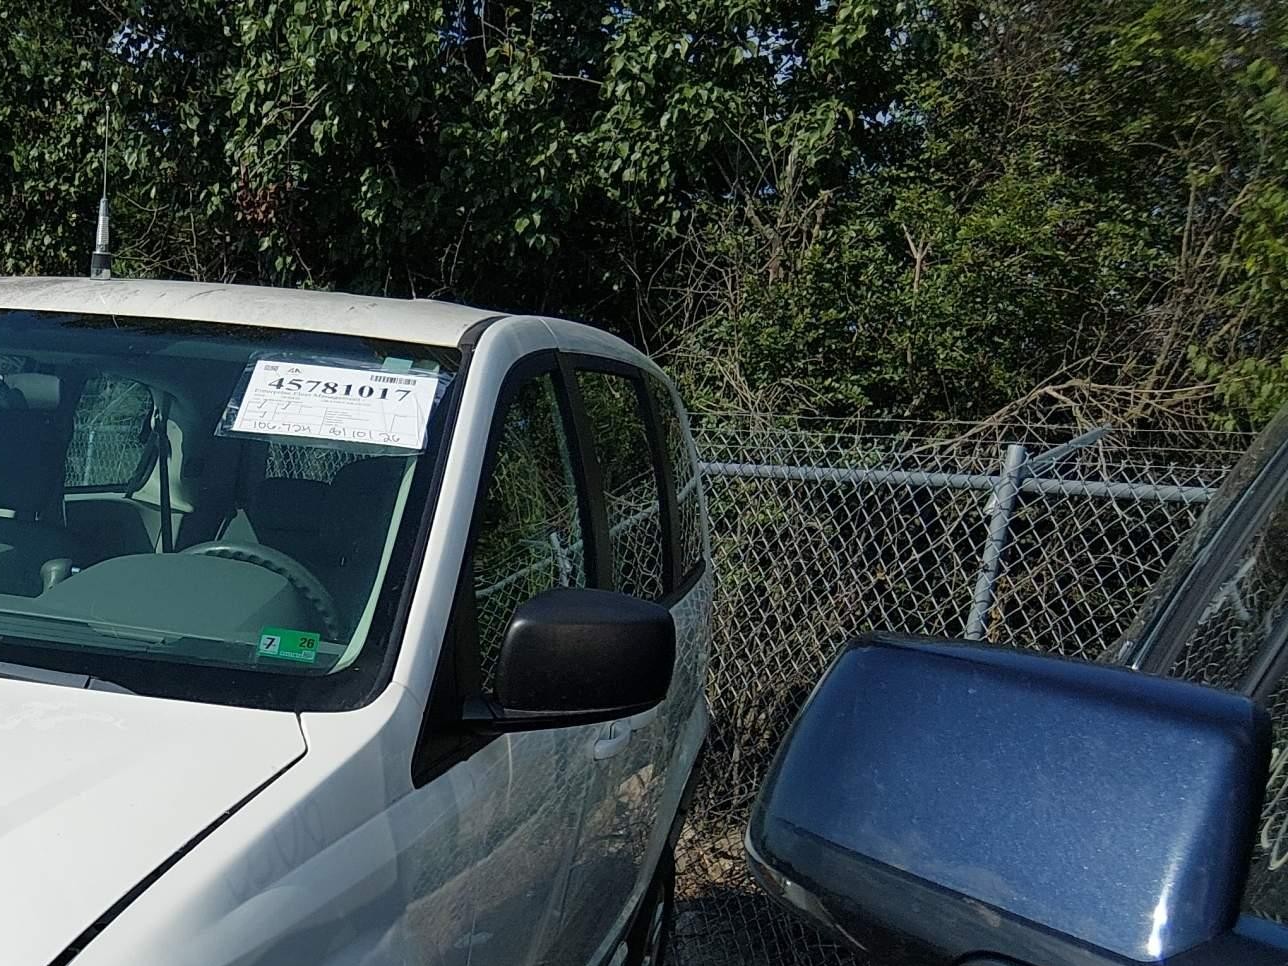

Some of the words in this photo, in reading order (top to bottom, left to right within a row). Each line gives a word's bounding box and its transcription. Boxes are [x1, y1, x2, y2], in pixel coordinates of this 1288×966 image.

[268, 376, 411, 402] 45781017
[266, 637, 276, 649] 7
[300, 638, 315, 648] 26
